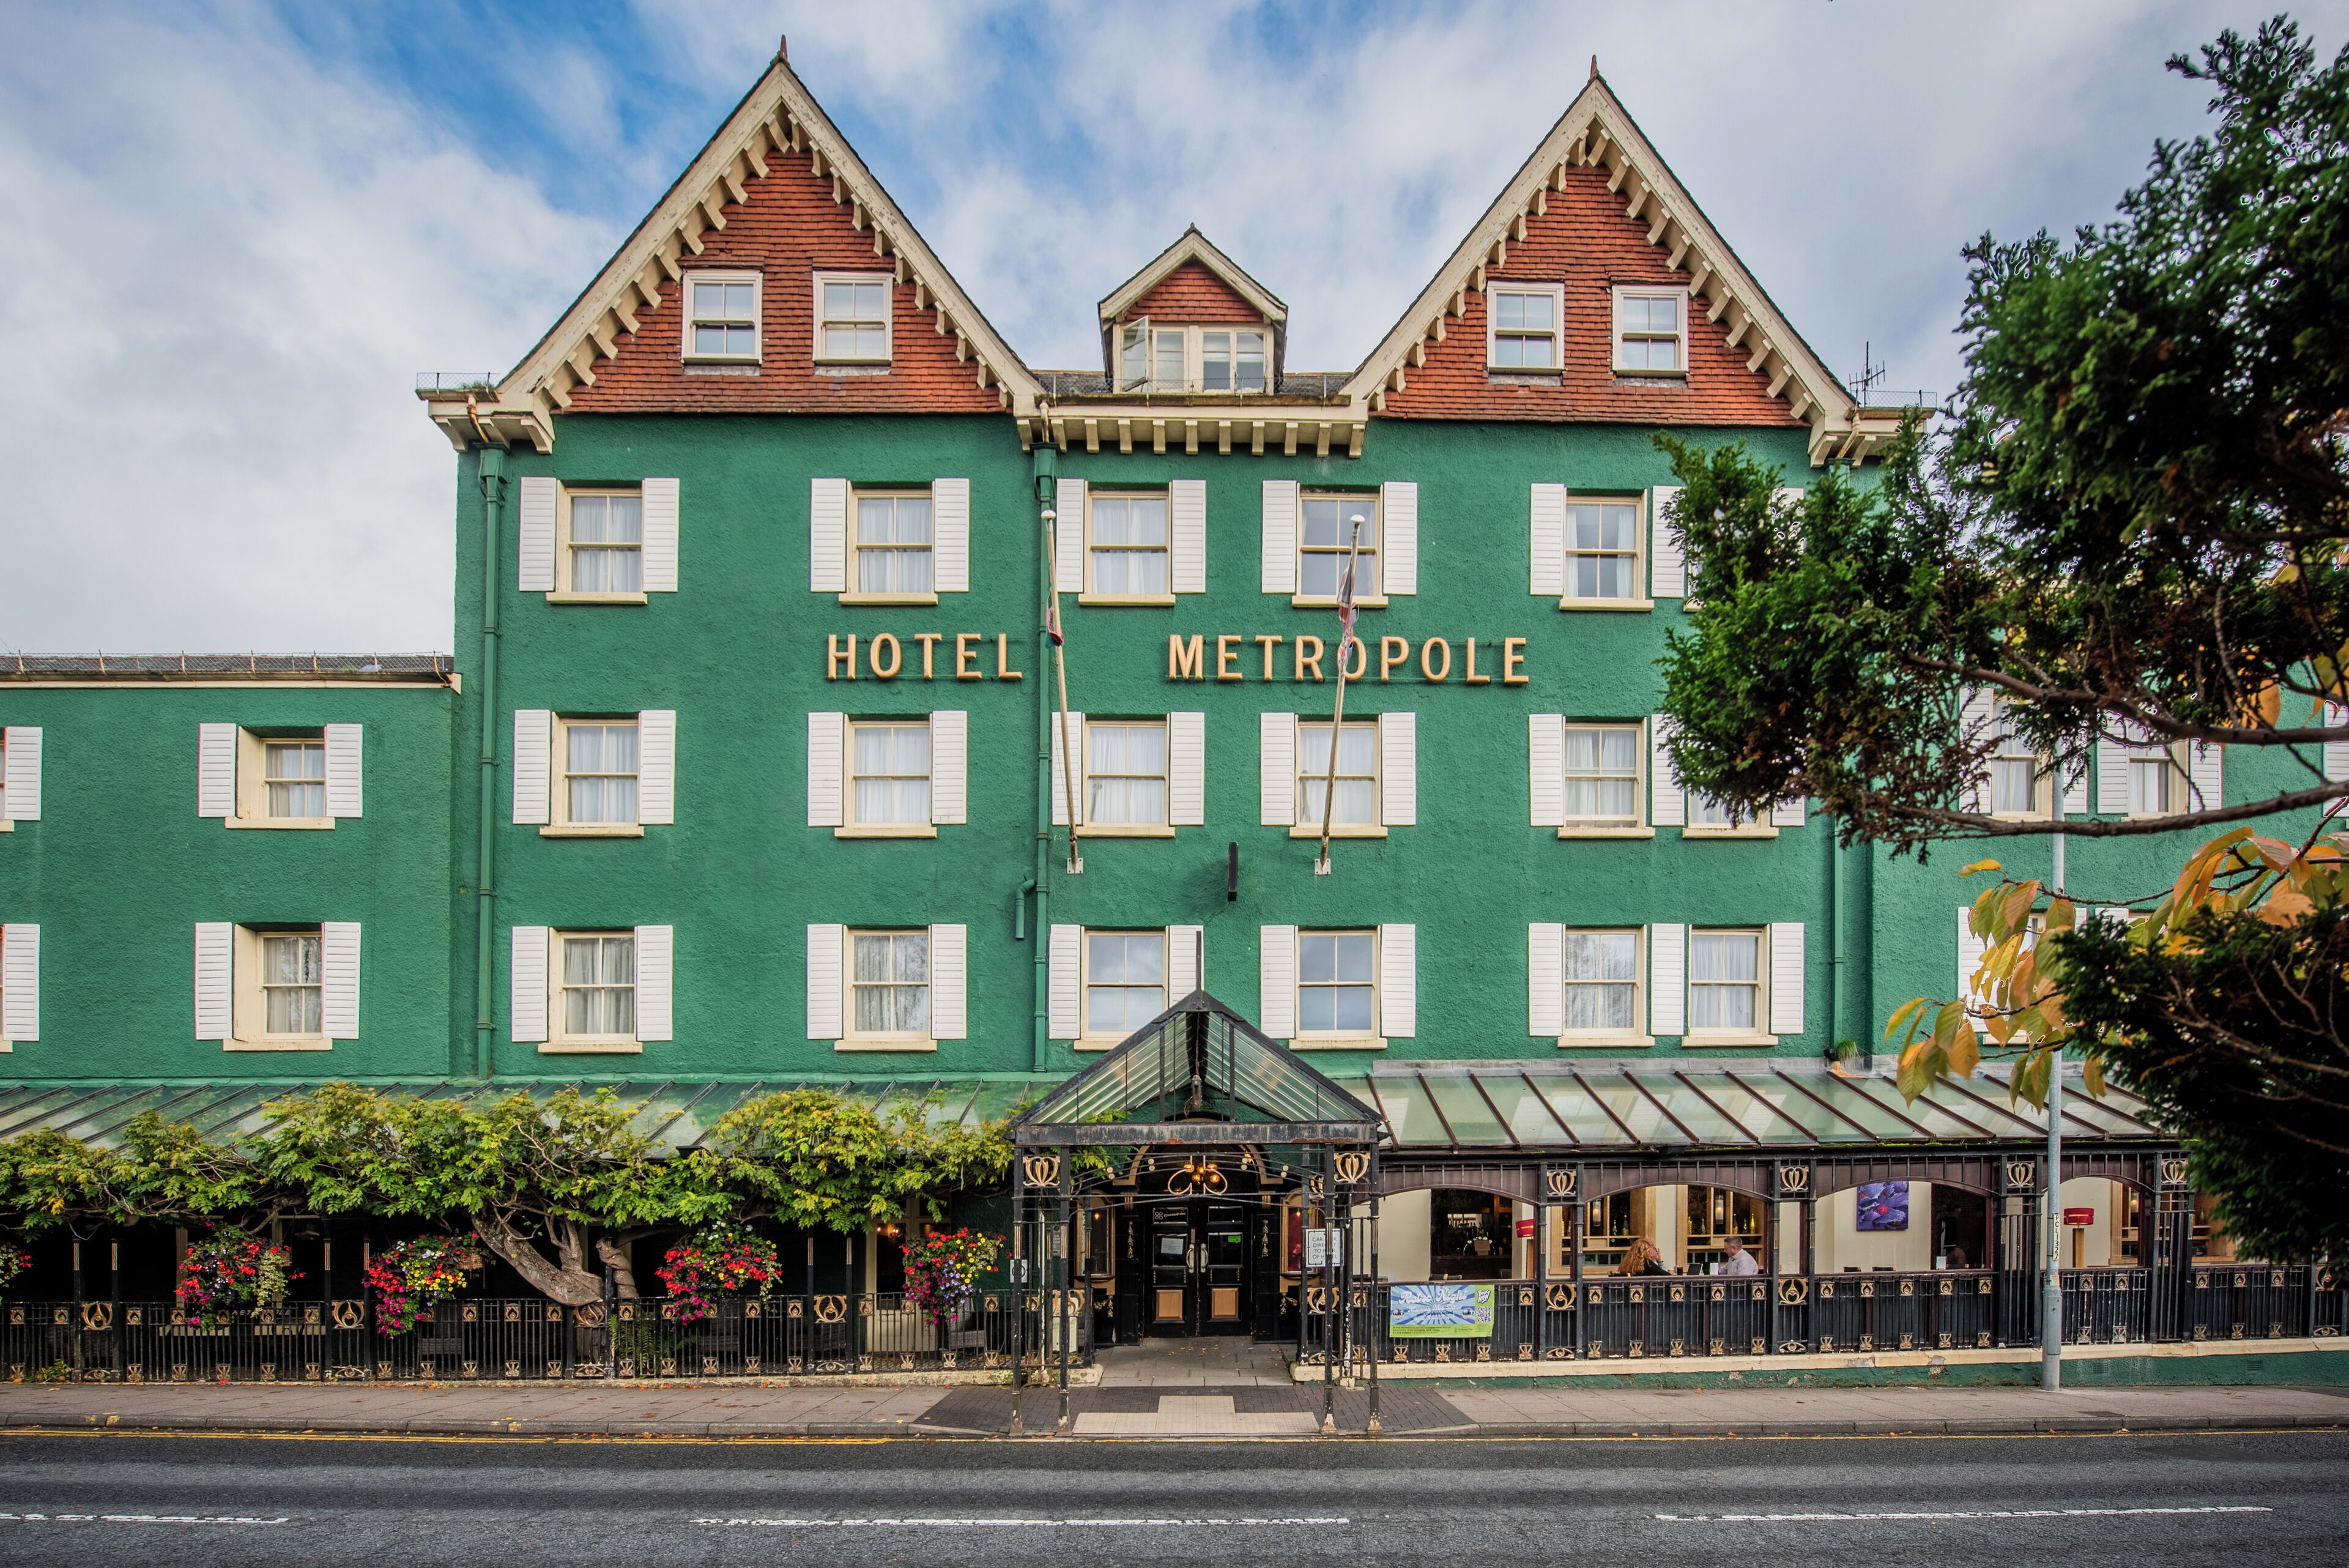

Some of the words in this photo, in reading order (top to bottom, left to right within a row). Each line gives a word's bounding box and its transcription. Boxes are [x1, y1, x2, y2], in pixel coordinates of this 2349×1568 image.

[827, 631, 1023, 680] HOTEL
[1168, 633, 1530, 685] METROPOLE
[1398, 1291, 1431, 1304] Retro
[1436, 1287, 1468, 1304] Night
